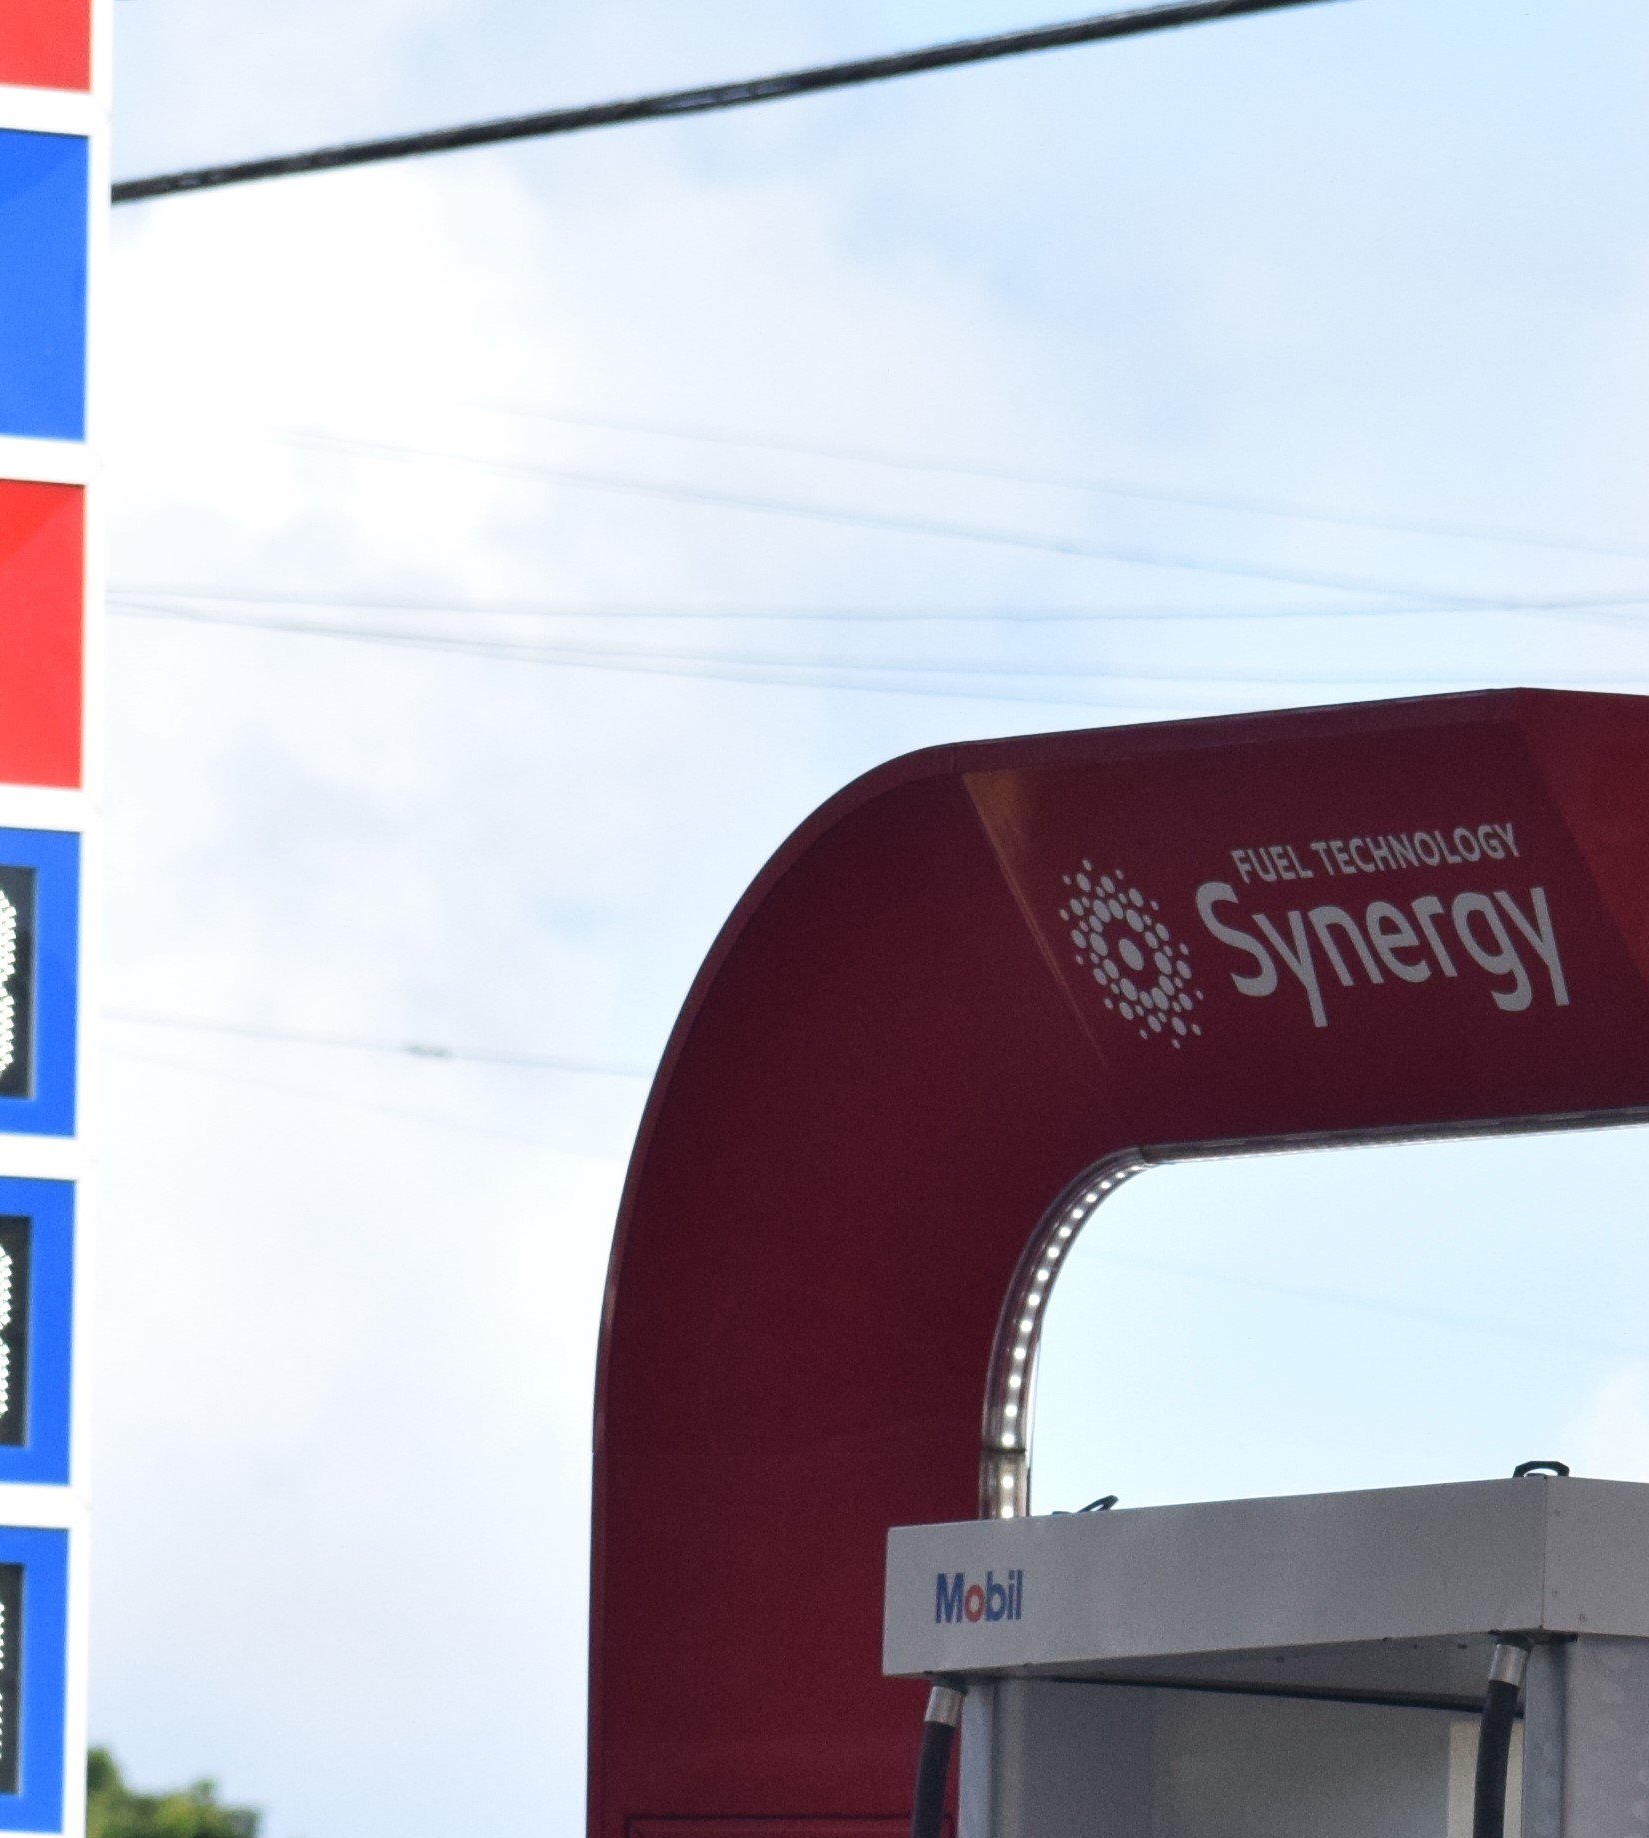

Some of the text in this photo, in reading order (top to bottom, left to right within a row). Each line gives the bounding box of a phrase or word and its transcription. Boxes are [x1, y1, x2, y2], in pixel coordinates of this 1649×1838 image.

[1231, 822, 1520, 884] FUEL TECHNOLOGY
[1195, 880, 1570, 1029] Synergy
[935, 1568, 1024, 1625] Mobil
